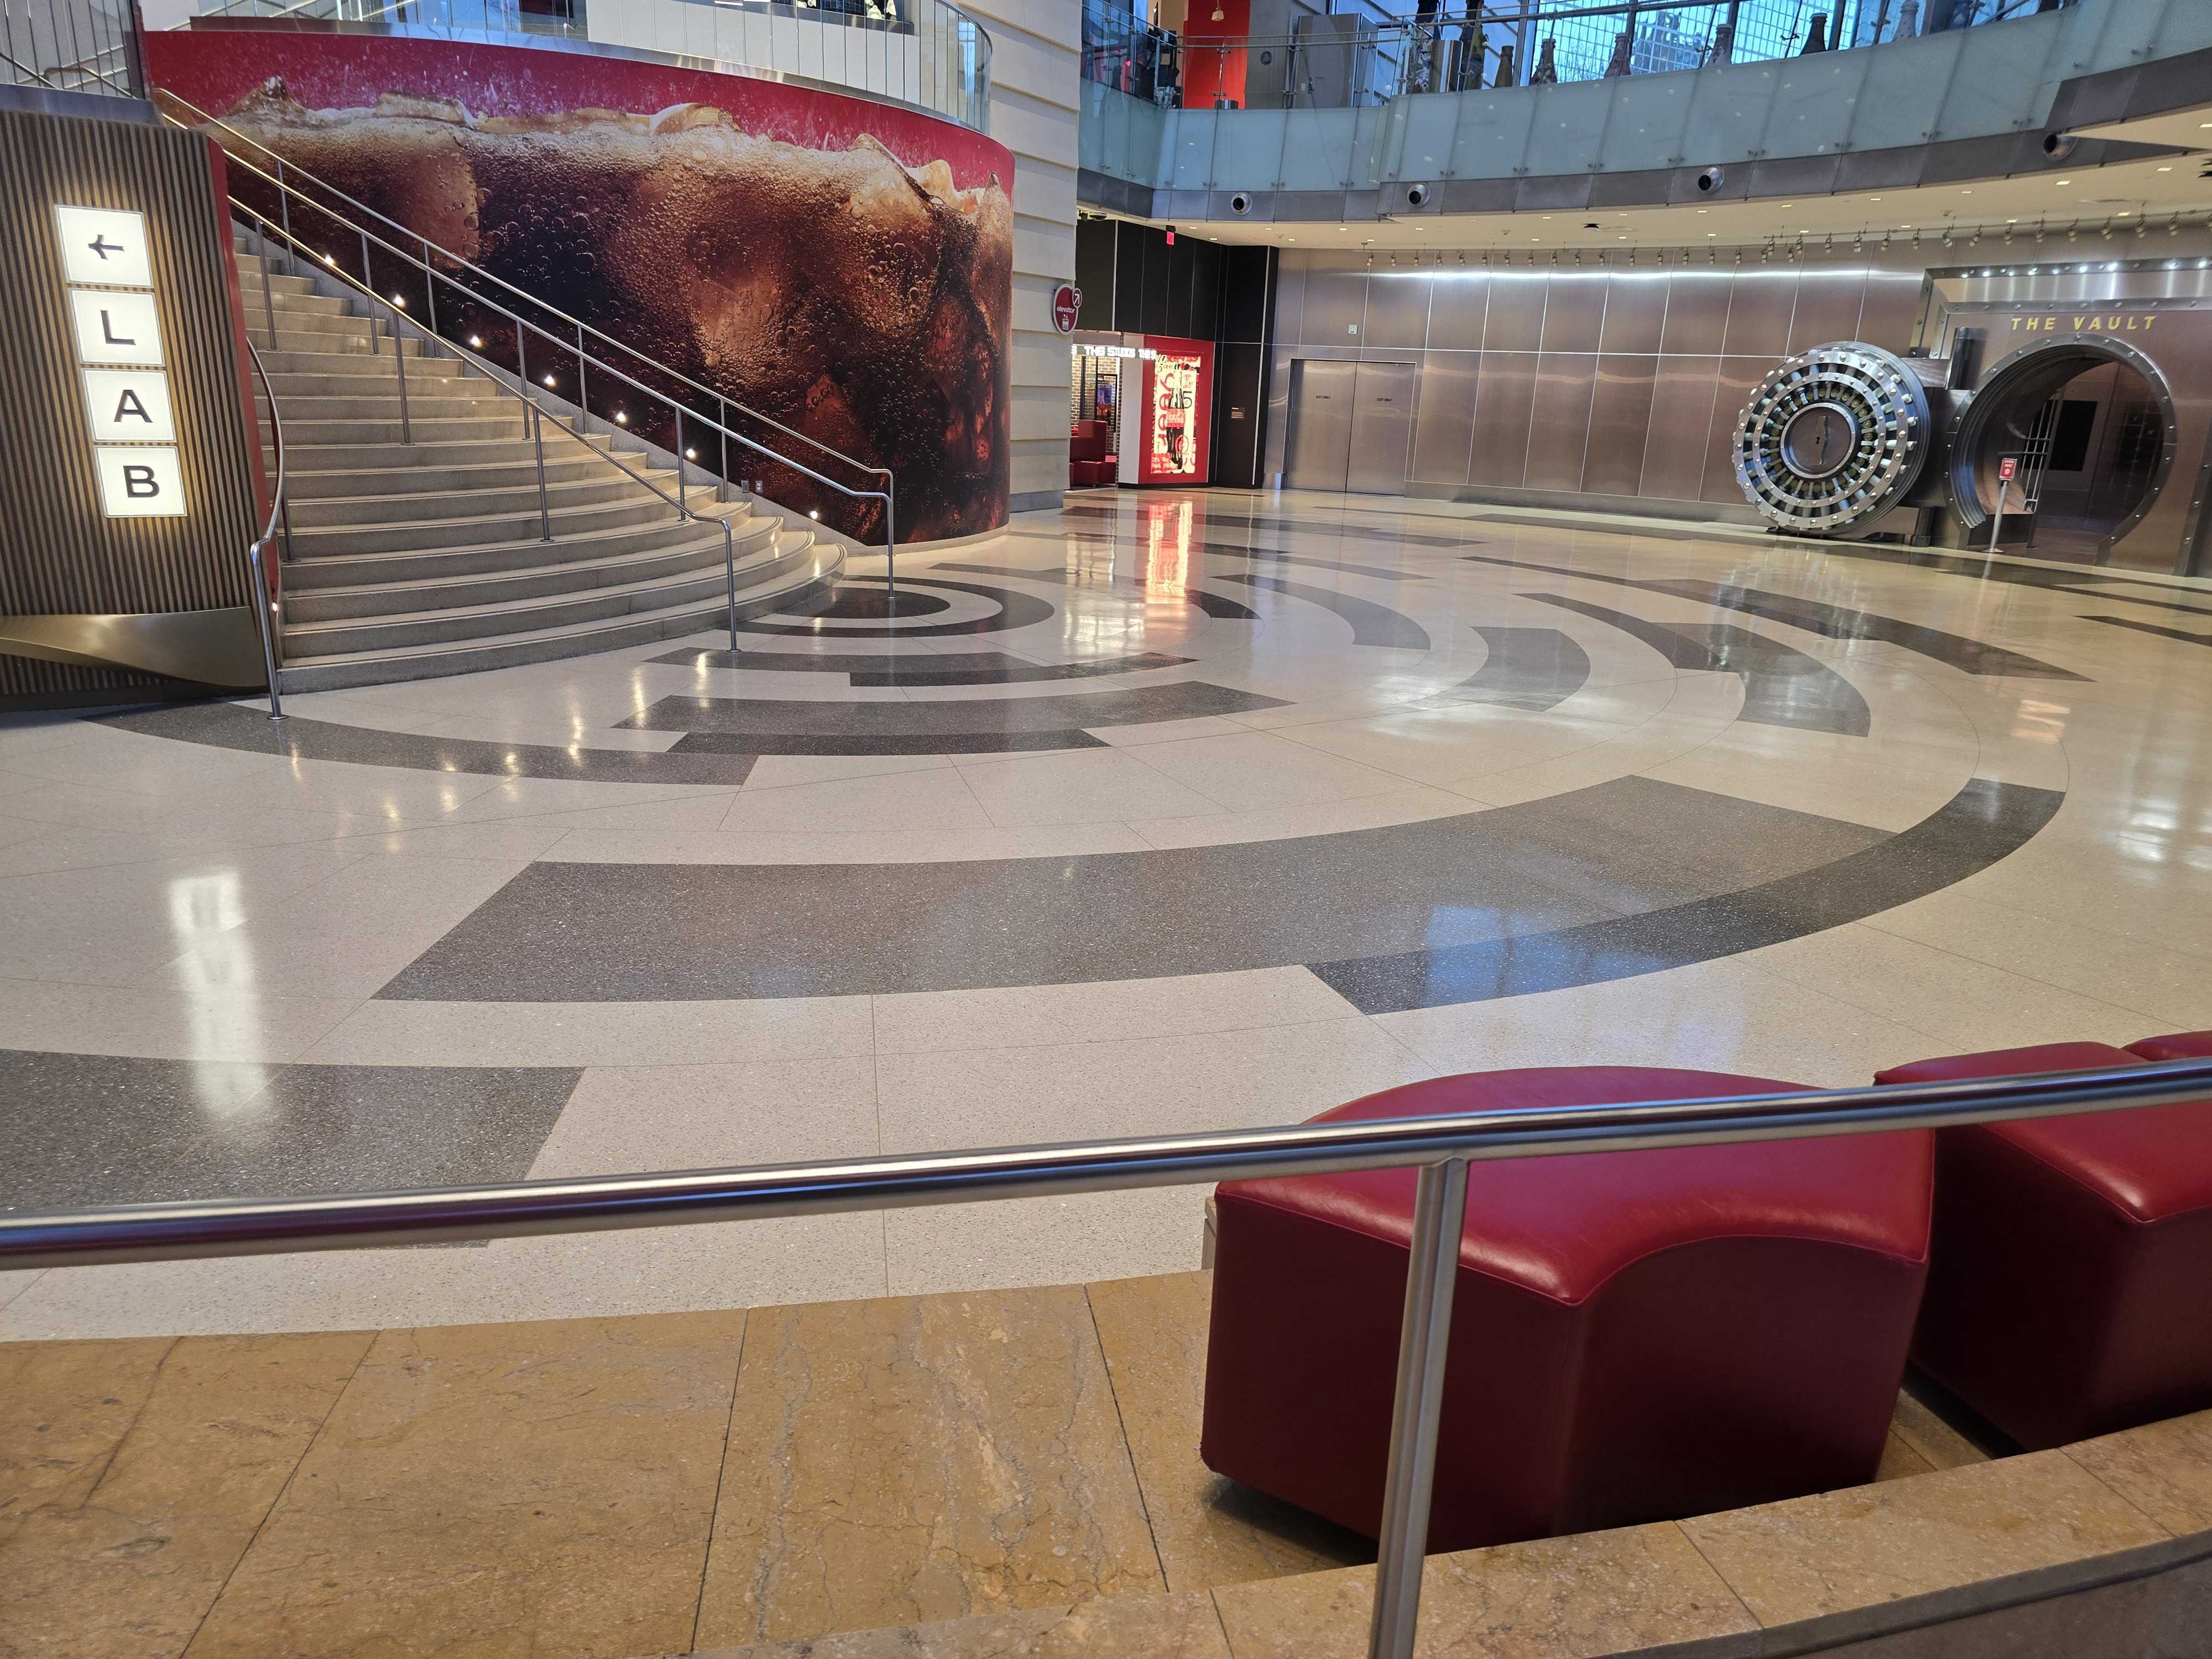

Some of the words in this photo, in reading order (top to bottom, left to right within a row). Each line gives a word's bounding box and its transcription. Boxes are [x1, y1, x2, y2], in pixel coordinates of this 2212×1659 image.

[2011, 317, 2056, 330] THE
[2074, 316, 2156, 330] VAULT
[100, 310, 159, 498] LAB
